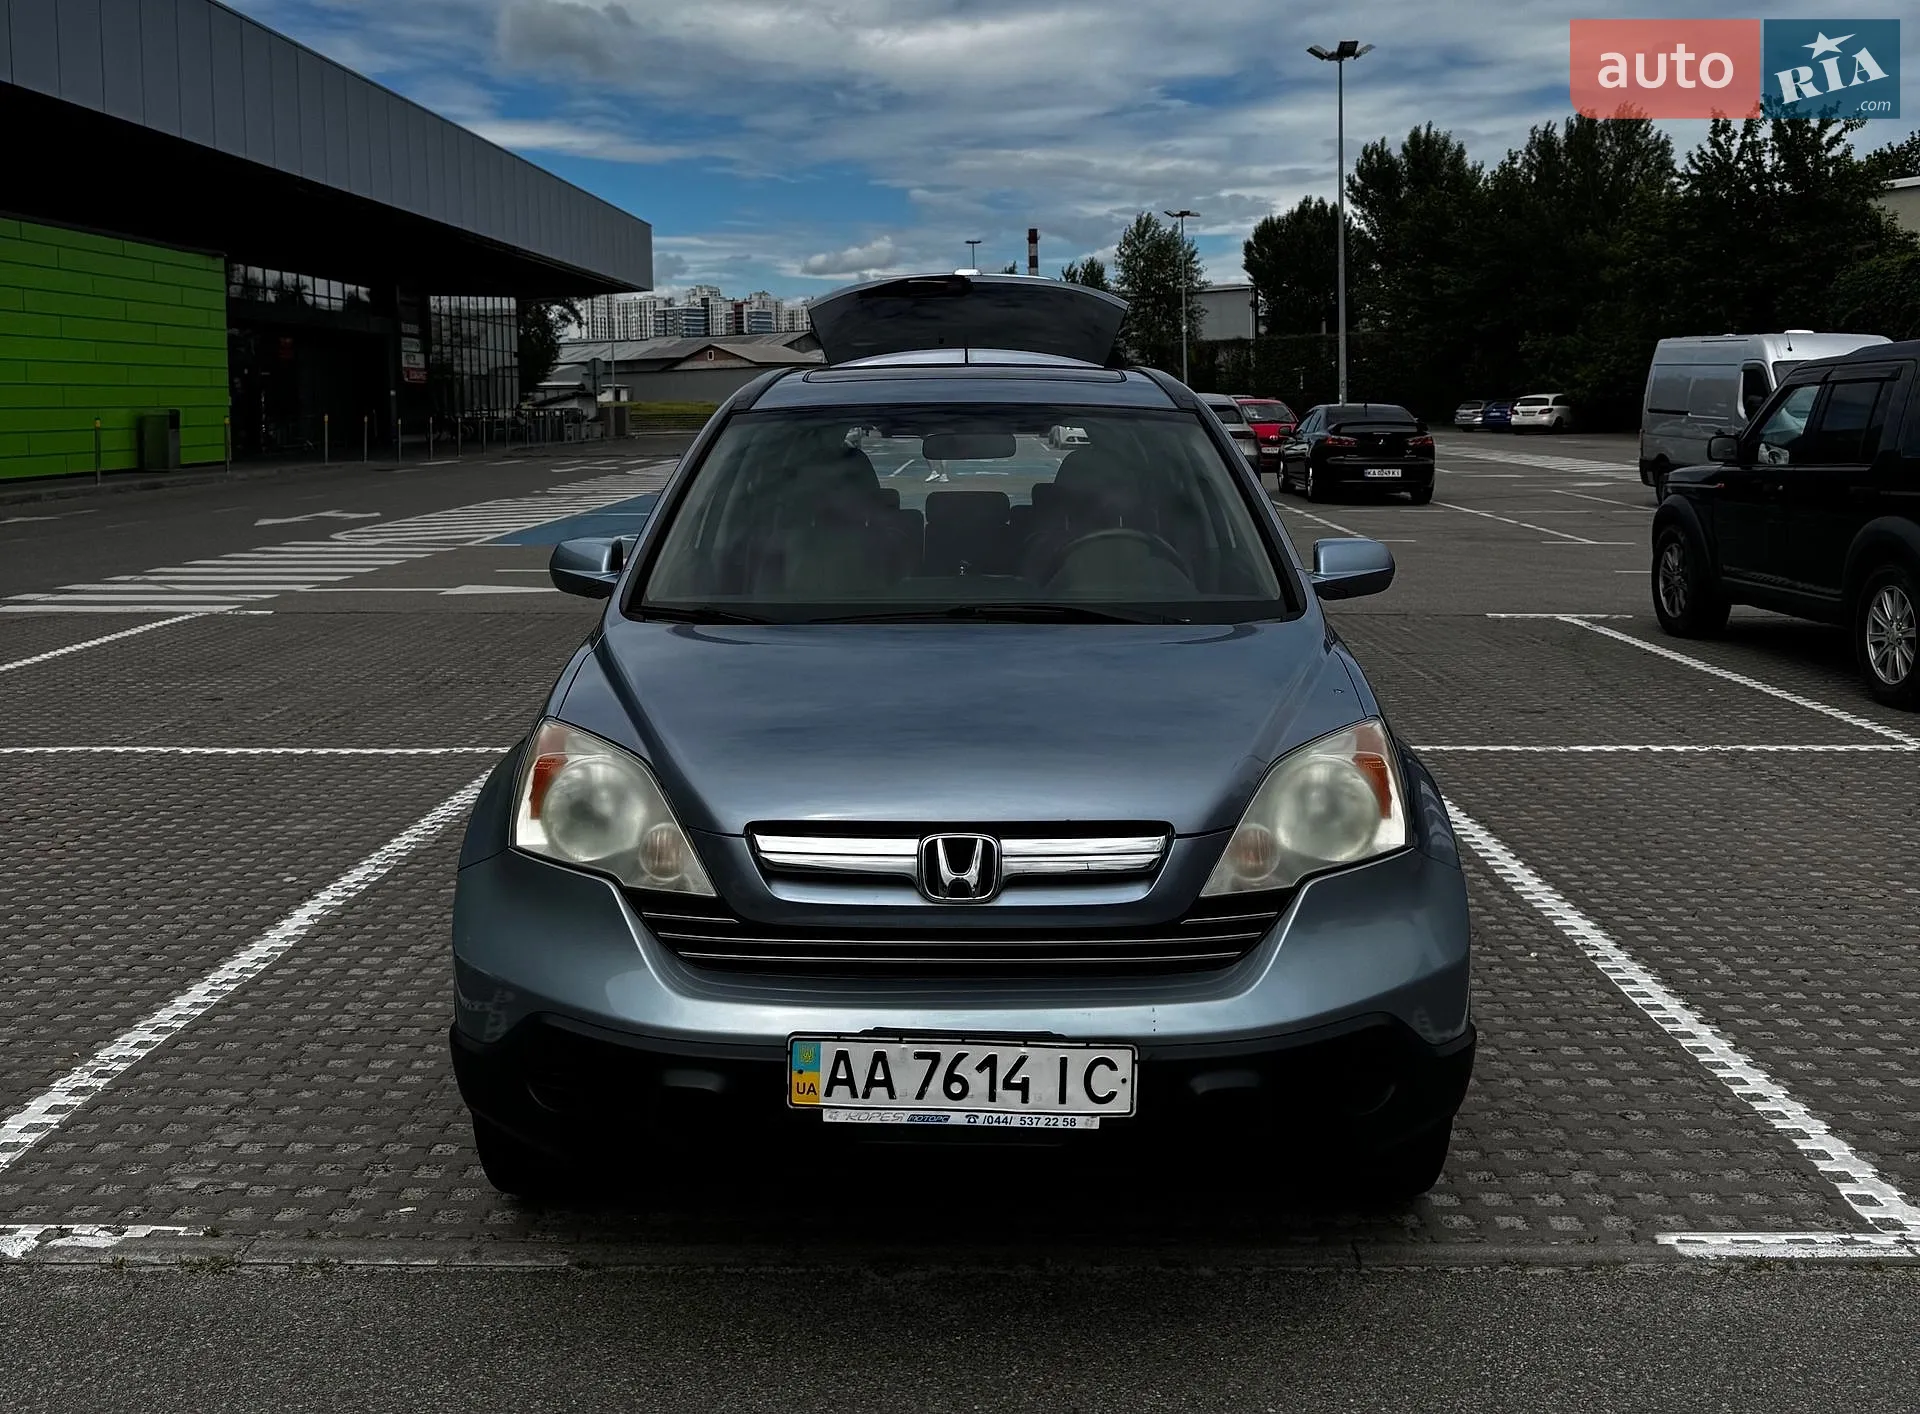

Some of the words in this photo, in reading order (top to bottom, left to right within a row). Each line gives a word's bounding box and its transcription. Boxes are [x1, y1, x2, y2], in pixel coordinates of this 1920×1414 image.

[823, 1049, 897, 1100] AA
[913, 1051, 1030, 1104] 7614
[1058, 1056, 1118, 1105] IC
[796, 1081, 818, 1097] UA
[1019, 1116, 1041, 1126] 537
[1044, 1117, 1059, 1126] 22
[1062, 1117, 1077, 1127] 58
